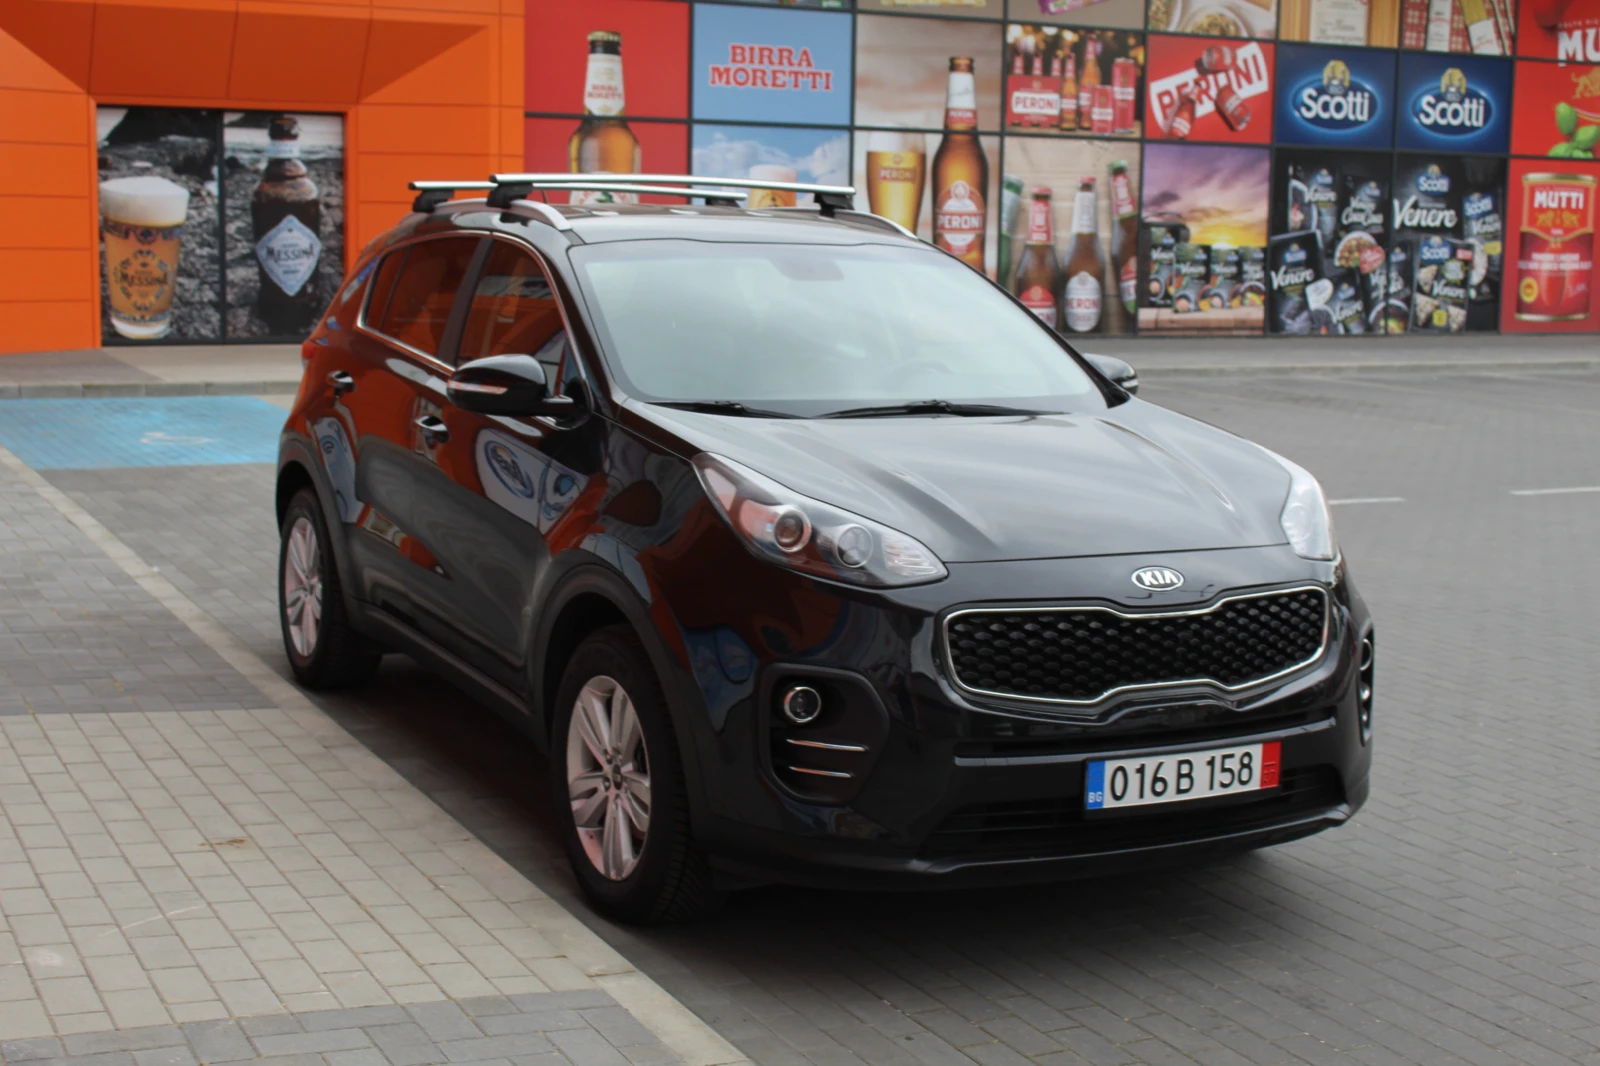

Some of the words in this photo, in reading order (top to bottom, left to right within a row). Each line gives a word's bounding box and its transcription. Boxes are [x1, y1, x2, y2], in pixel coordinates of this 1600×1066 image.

[730, 43, 813, 68] BIRRA
[709, 65, 832, 91] MORETTI
[1300, 87, 1369, 122] Scotti
[1419, 94, 1485, 127] Scotti
[1534, 189, 1584, 209] MUTTI
[1393, 195, 1458, 230] Venere
[1139, 569, 1179, 586] KIA
[1088, 792, 1103, 803] BG
